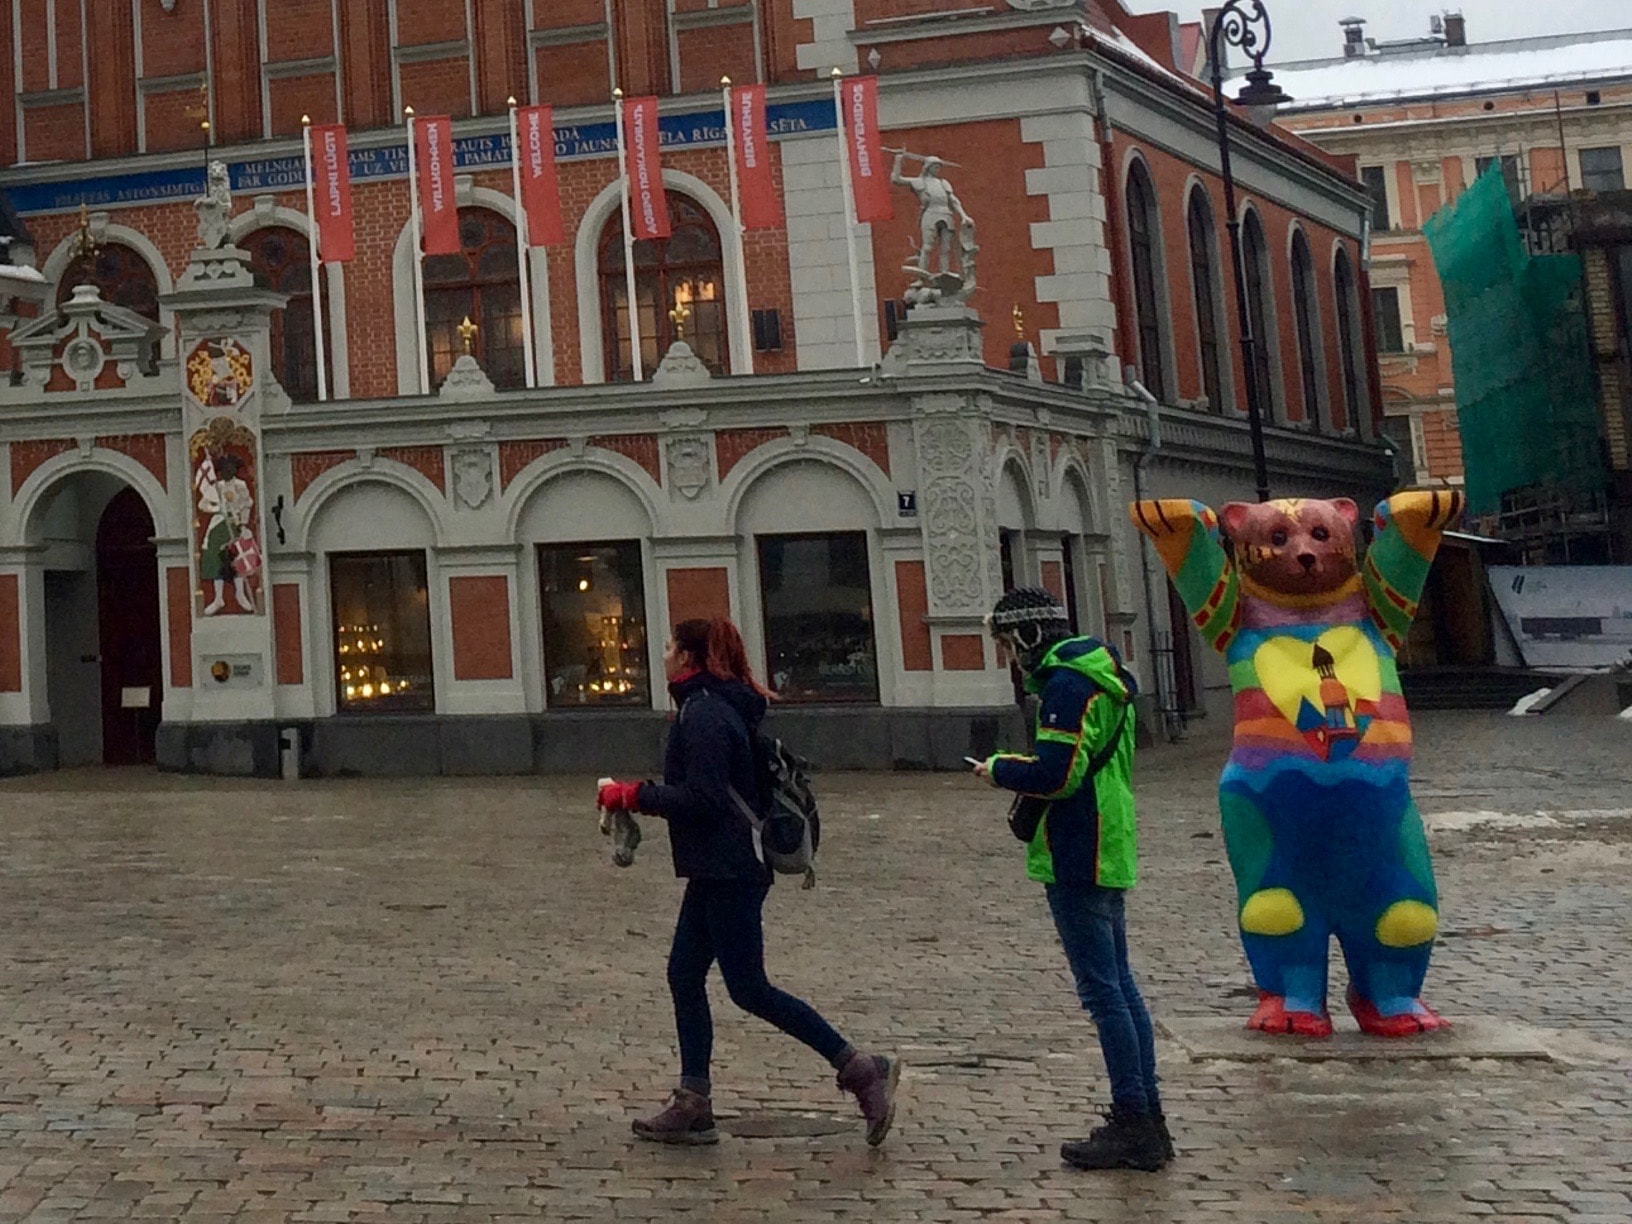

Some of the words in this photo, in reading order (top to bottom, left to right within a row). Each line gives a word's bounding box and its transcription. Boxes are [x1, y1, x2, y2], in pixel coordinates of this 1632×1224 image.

[528, 112, 543, 178] WELCOME
[742, 91, 756, 168] BIENVENUE
[853, 84, 872, 177] BIENVENIDOS
[328, 172, 341, 216] LAIPNI
[427, 123, 443, 212] WILLKOMMEN
[902, 495, 910, 508] 7
